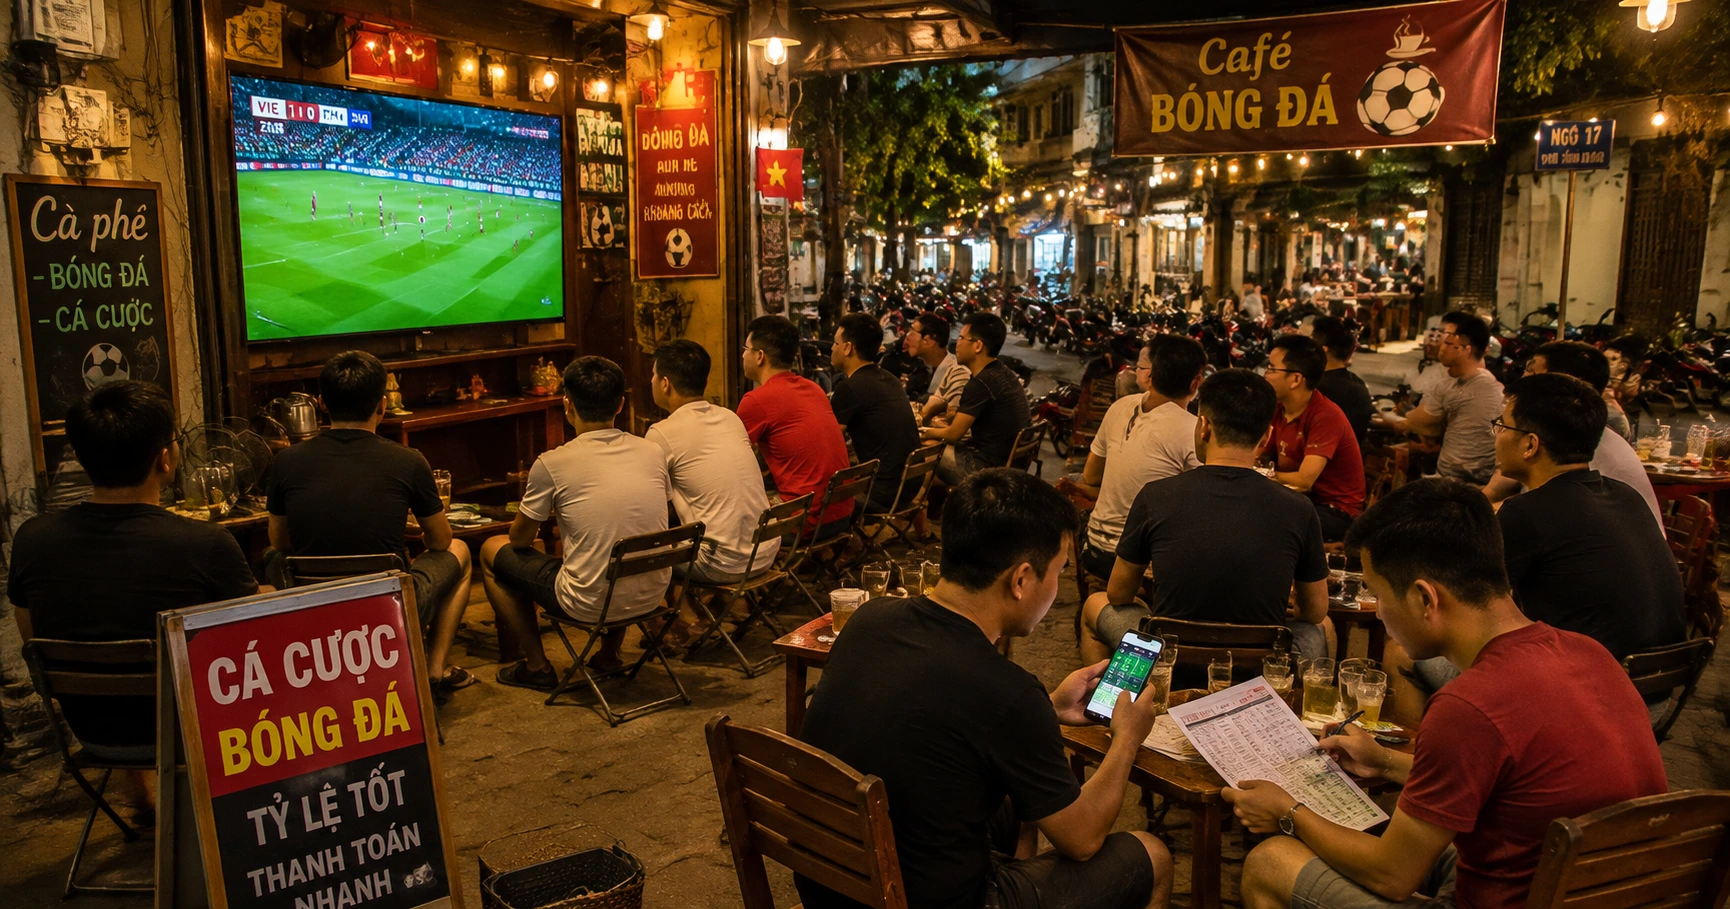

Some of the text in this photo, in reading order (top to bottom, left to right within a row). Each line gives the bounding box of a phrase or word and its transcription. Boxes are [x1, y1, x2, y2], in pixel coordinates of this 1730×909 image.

[1199, 30, 1292, 81] Café
[257, 100, 279, 115] VIE
[1151, 72, 1339, 133] BÓNG ĐÁ
[1585, 125, 1603, 145] 17
[31, 195, 149, 253] Cà phê
[49, 254, 113, 290] BÓNG
[118, 254, 150, 288] ĐÁ
[55, 298, 89, 333] CÁ
[207, 624, 400, 705] CÁ CƯỢC
[218, 680, 411, 776] BÓNG ĐÁ
[246, 761, 406, 846] TỶ LỆ TỐT
[246, 822, 422, 898] THANH TOÁN
